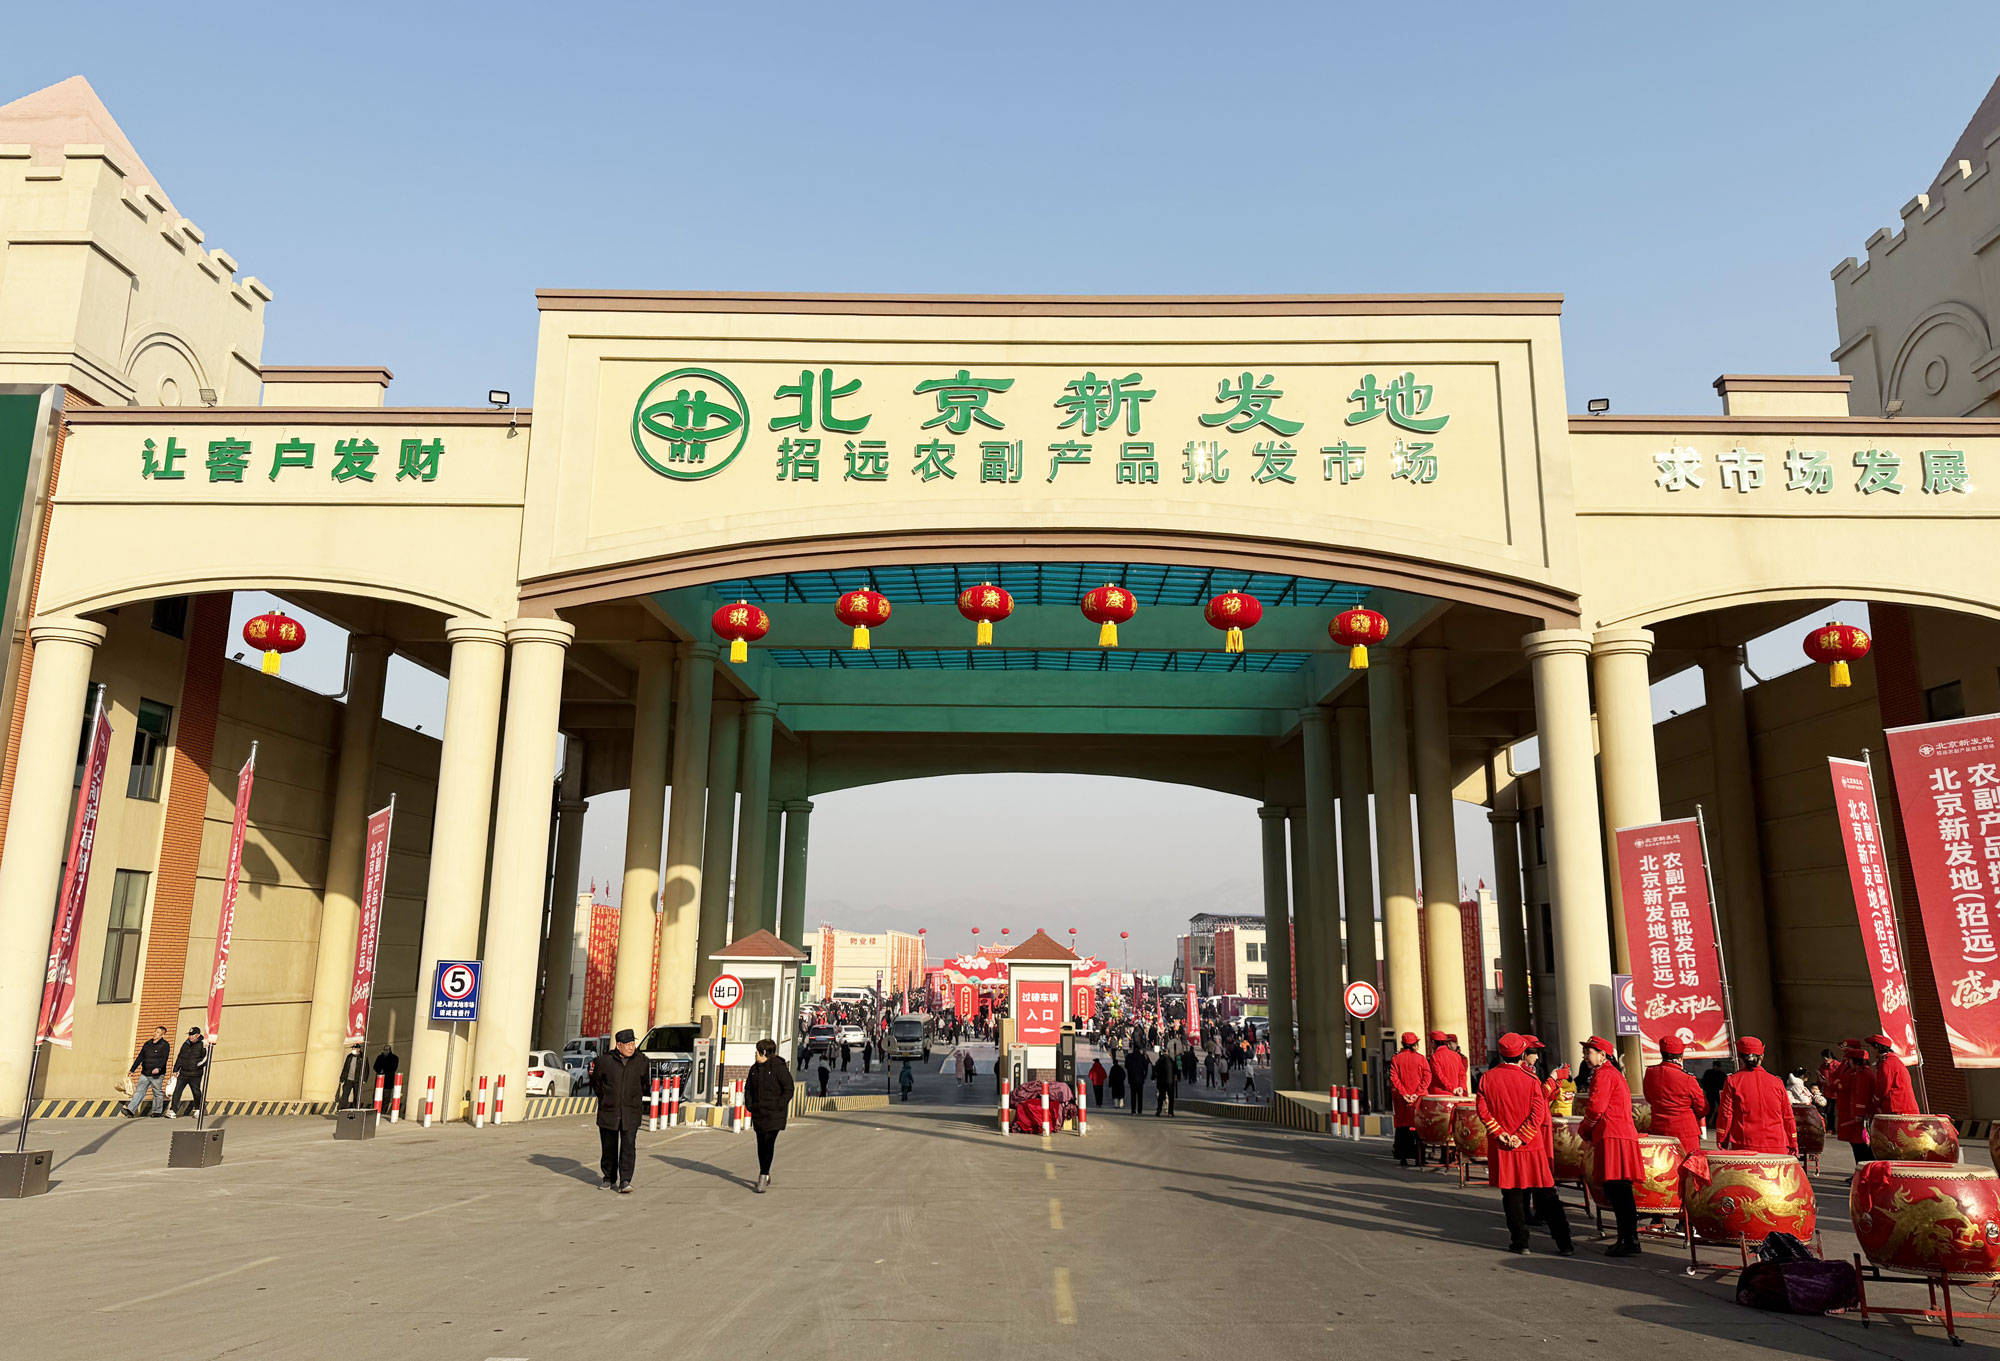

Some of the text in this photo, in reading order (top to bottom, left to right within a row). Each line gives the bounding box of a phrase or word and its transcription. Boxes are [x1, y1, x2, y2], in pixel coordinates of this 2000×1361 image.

[770, 369, 1451, 435] 北京新发地
[142, 437, 445, 483] 让客户发财
[776, 438, 1439, 484] 招远农副产品批发市场
[1653, 447, 1974, 494] 求市场发展
[1662, 852, 1699, 987] 农副产品批发市场
[450, 971, 465, 992] 5
[715, 985, 737, 998] 出口
[1022, 992, 1058, 1002] 过磅车辆
[1351, 993, 1373, 1006] 入口
[1644, 993, 1721, 1021] 盛大开业
[1026, 1008, 1053, 1021] 入口
